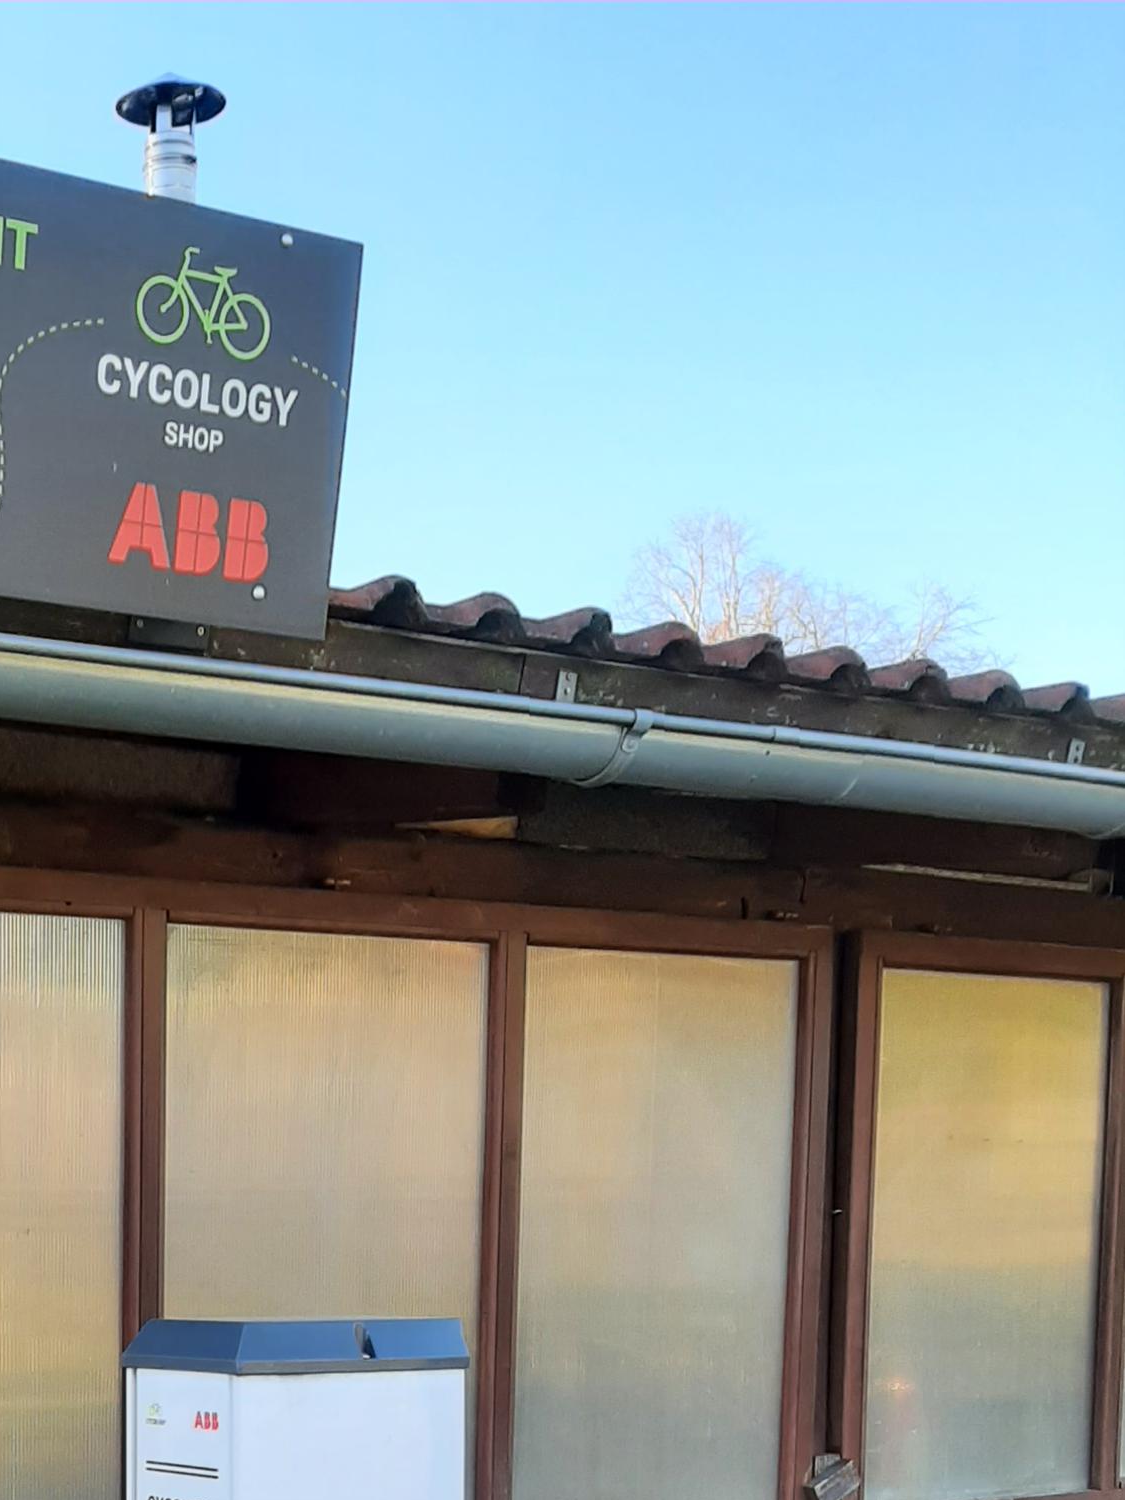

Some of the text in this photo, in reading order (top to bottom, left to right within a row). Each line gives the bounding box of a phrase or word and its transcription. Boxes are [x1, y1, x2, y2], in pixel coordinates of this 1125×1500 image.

[97, 353, 299, 428] CYCOLOGY
[164, 421, 225, 453] SHOP
[107, 482, 269, 584] ABB
[194, 1411, 219, 1431] ABB
